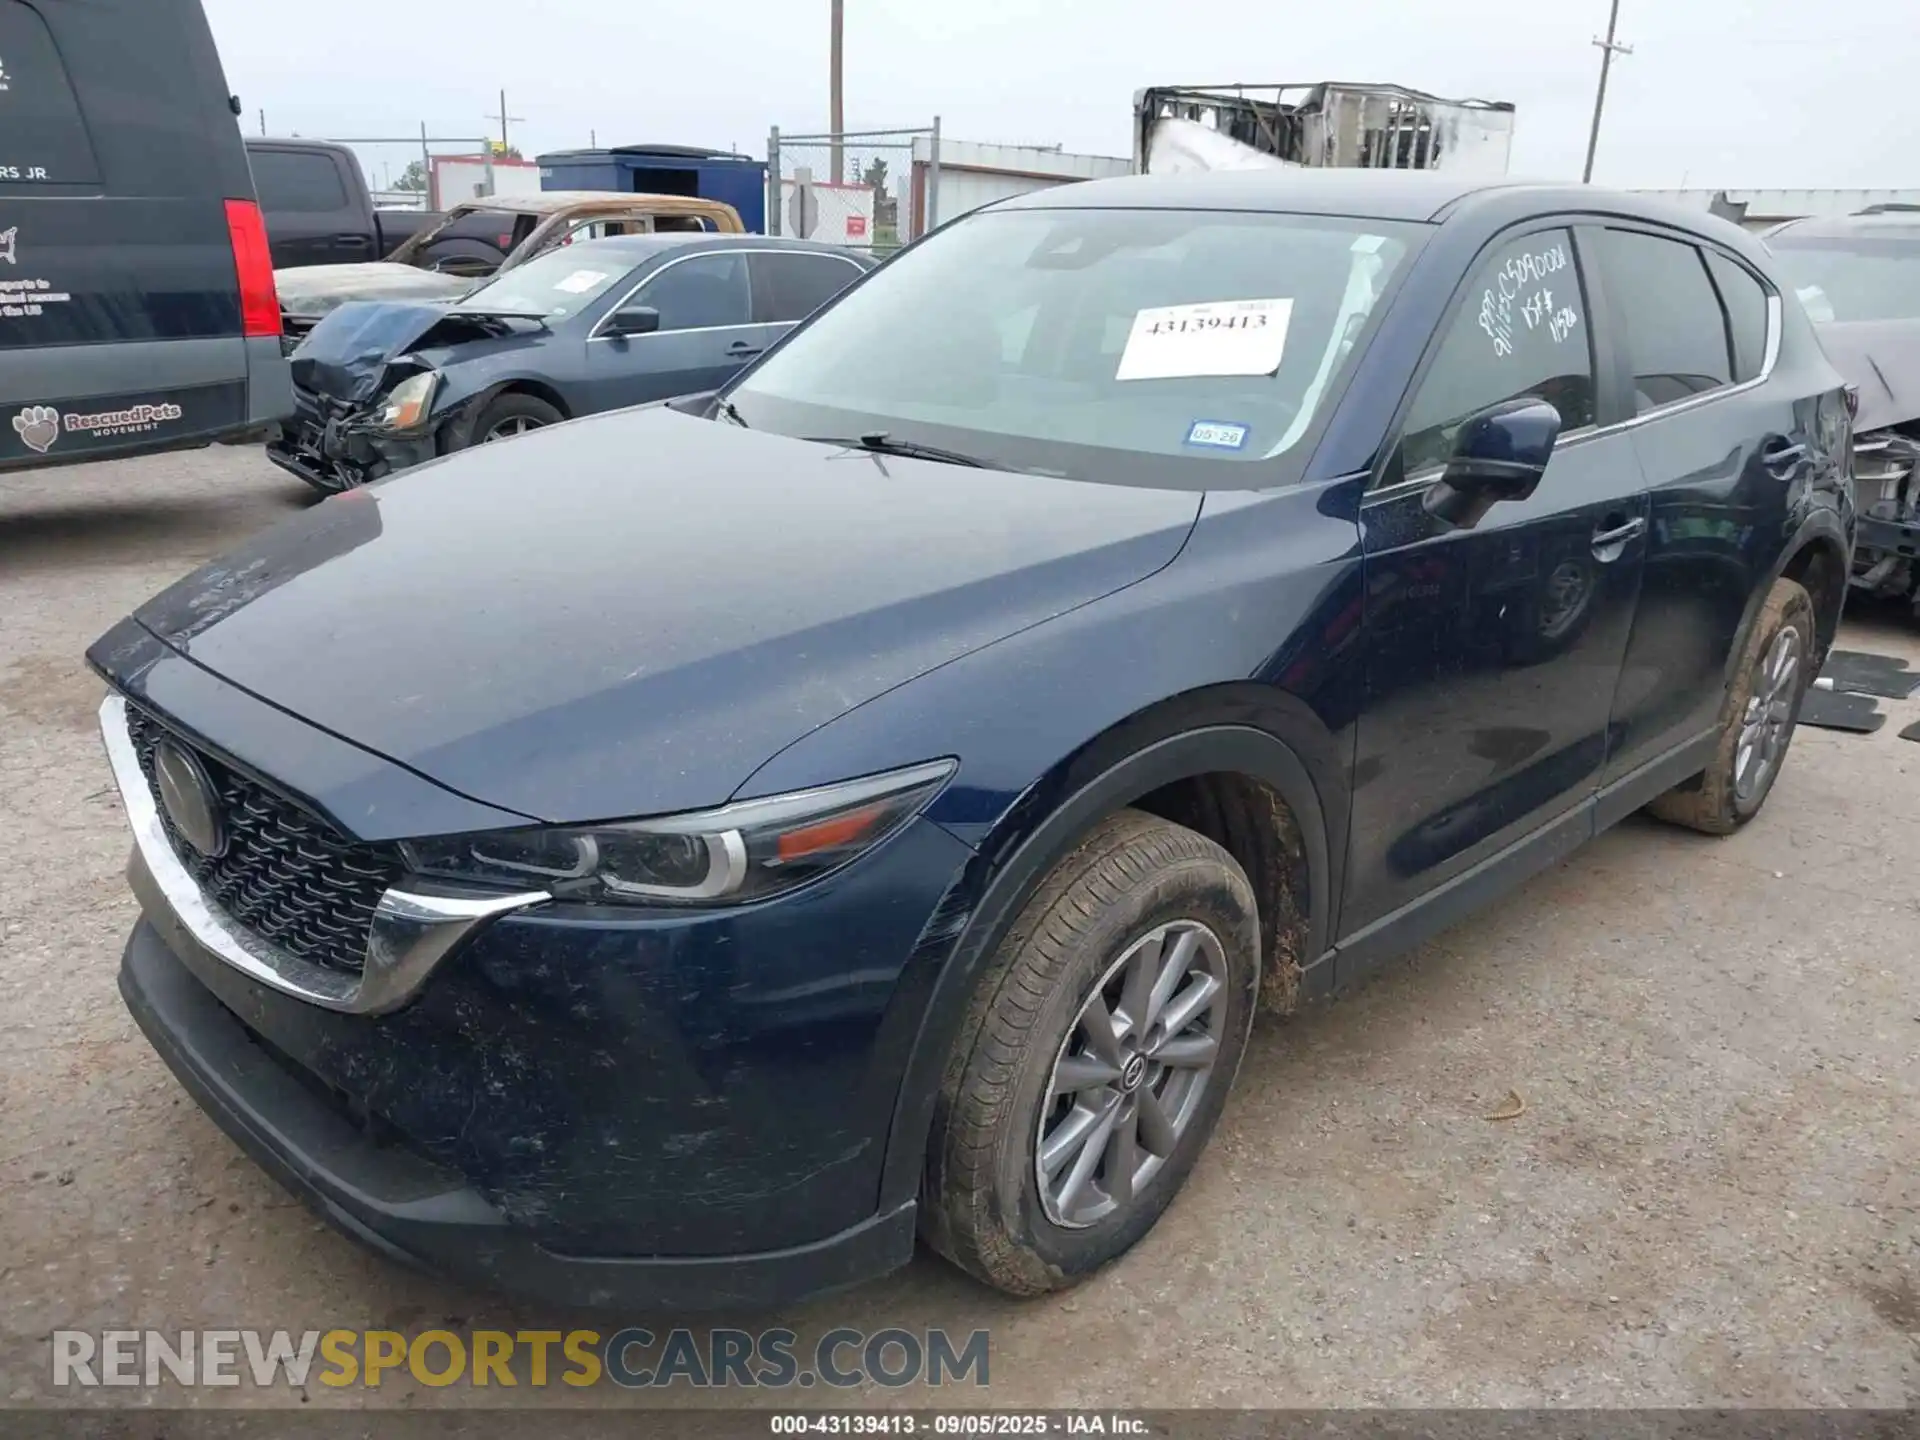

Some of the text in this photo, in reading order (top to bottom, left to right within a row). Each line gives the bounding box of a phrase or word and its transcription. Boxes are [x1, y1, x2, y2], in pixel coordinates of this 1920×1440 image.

[1146, 315, 1268, 336] 43139413
[64, 403, 182, 431] RescuedPets
[93, 423, 159, 437] MOVEMENT
